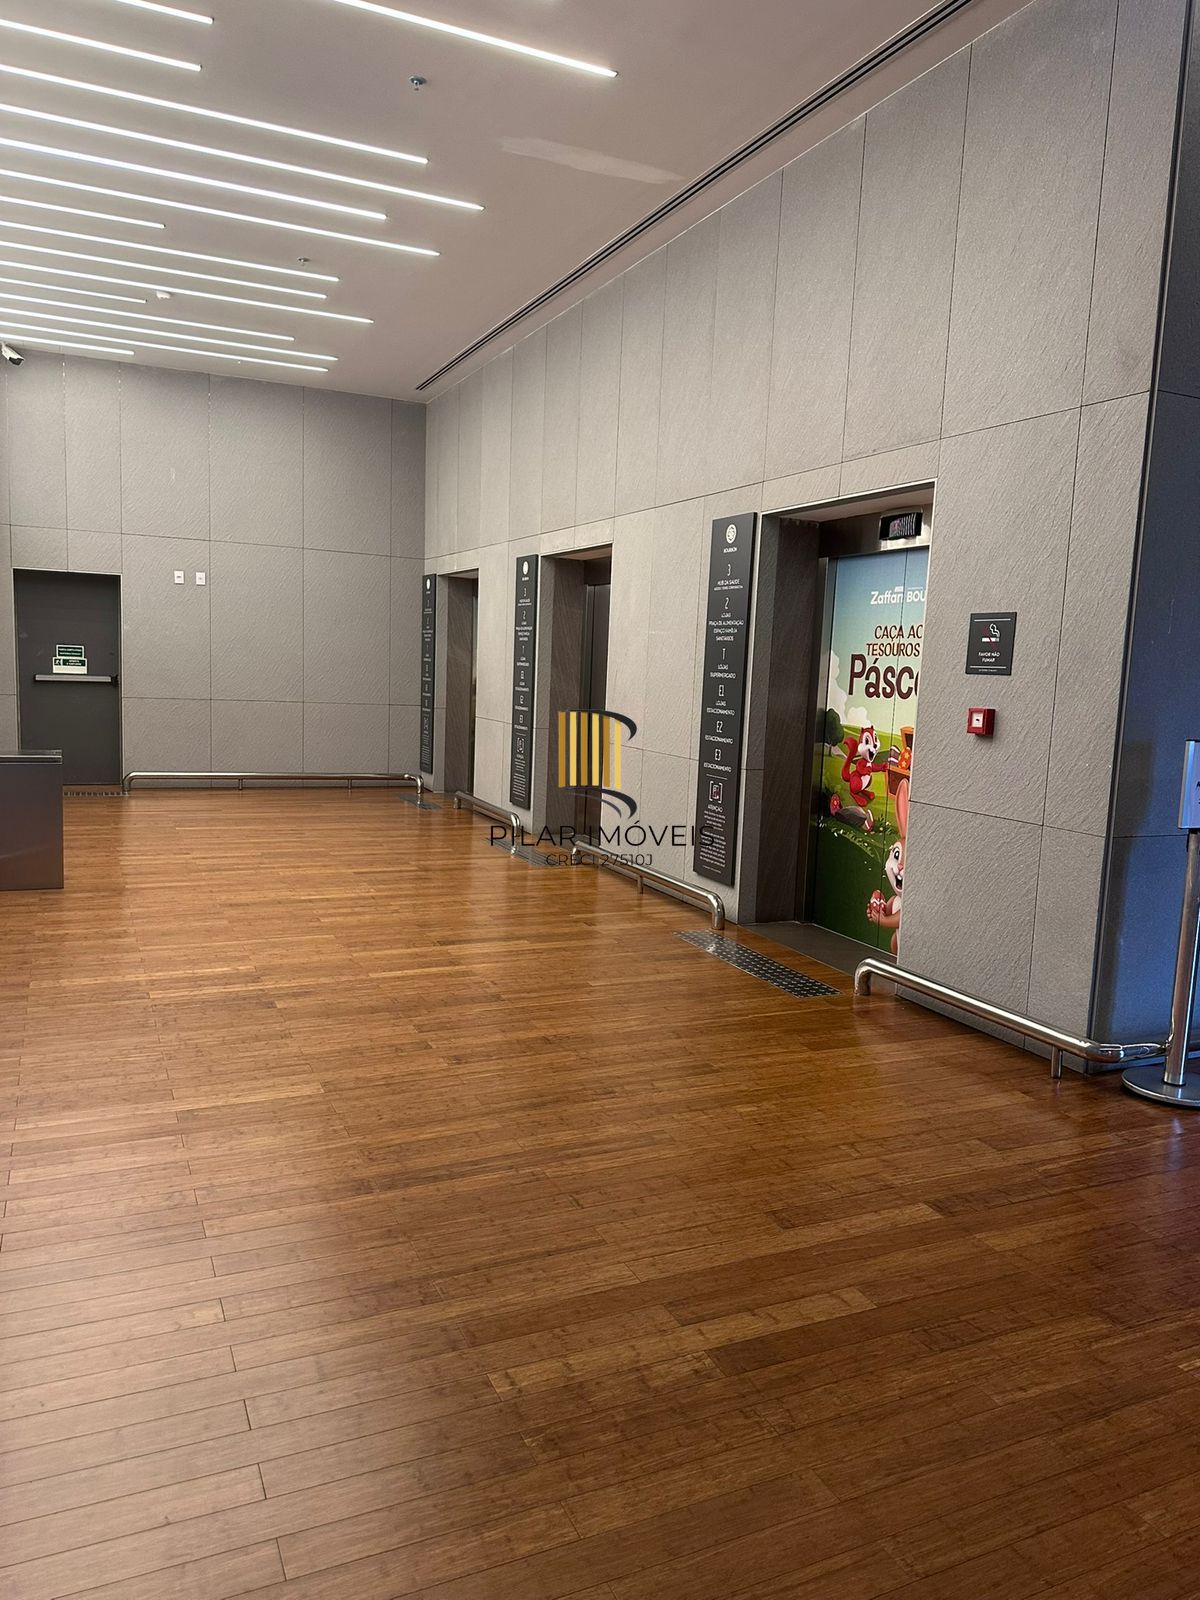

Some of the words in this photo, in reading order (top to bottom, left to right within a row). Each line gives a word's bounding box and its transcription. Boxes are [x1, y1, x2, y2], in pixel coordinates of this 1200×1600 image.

[724, 597, 730, 610] 2
[874, 624, 904, 641] CAÇA
[866, 642, 921, 657] TESOUROS
[716, 720, 723, 733] E2
